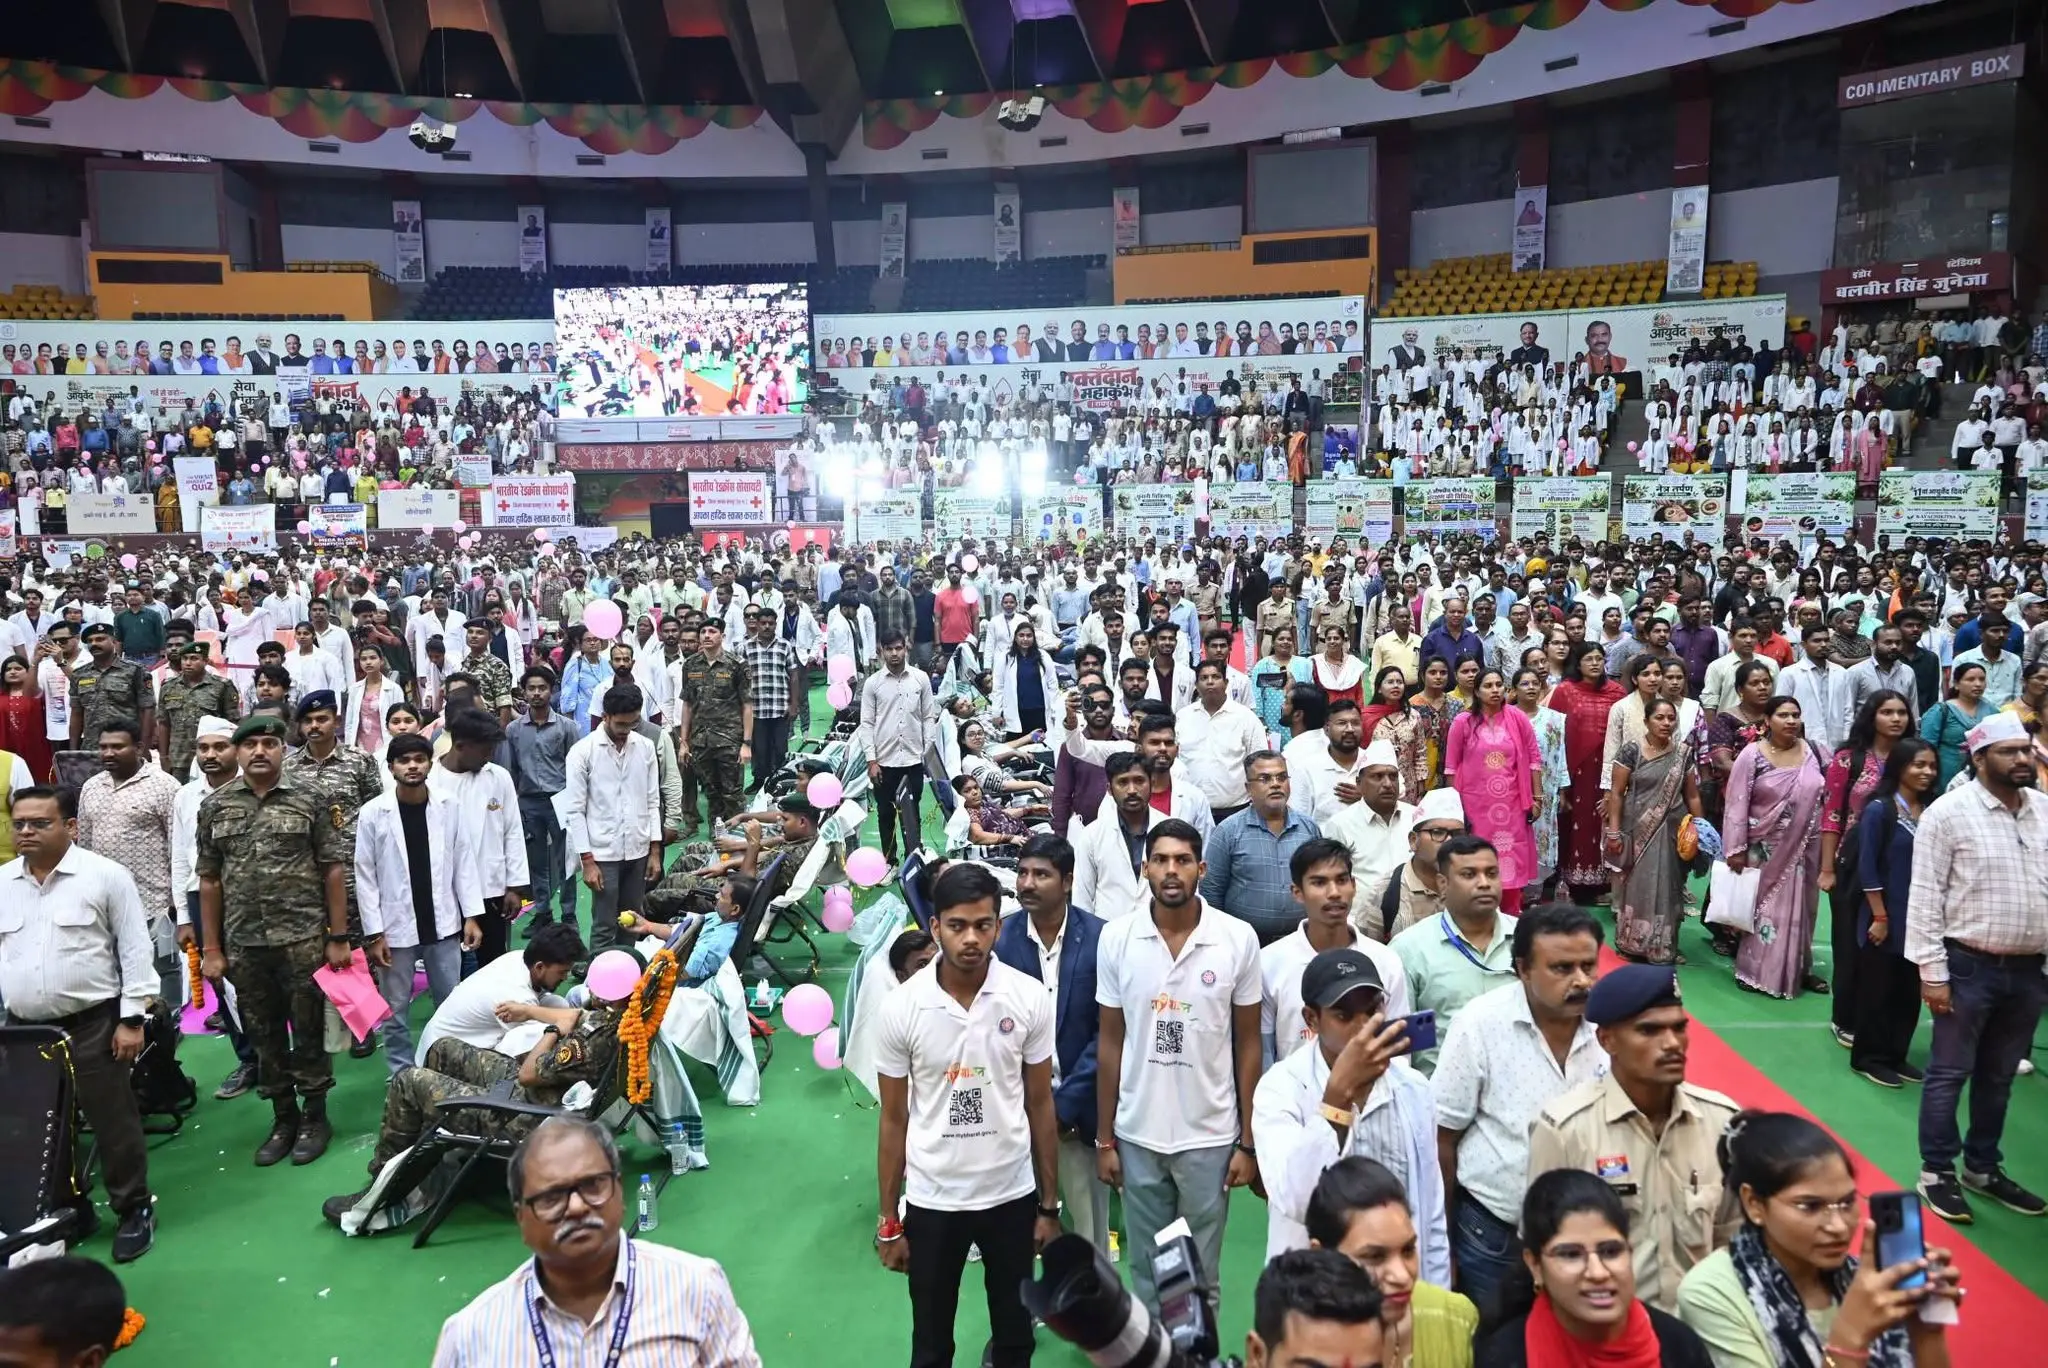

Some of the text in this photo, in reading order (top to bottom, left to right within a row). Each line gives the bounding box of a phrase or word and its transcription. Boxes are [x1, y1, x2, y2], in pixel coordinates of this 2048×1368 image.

[1846, 55, 2011, 99] COMMENTARY BOX
[1852, 257, 1982, 280] इंडोर स्टेडियम
[1836, 271, 1990, 298] बलबीर सिंह जुनेजा
[1649, 322, 1687, 341] आयुर्वेद
[1688, 323, 1706, 337] सेवा
[233, 378, 257, 392] सेवा
[191, 481, 214, 491] QUIZ
[496, 481, 569, 496] भारतीय रेडक्रॉस सोसायटी
[692, 478, 762, 492] भारतीय रेडक्रॉस सोसायटी
[1656, 483, 1694, 492] नेत्र तर्पण
[1929, 486, 1949, 496] आयुर्वेद
[1950, 486, 1968, 495] दिवस
[497, 514, 515, 524] आपका
[516, 512, 533, 525] हार्दिक
[534, 514, 550, 524] स्वागत
[551, 514, 566, 524] करता
[693, 511, 710, 520] आपका
[710, 509, 727, 520] हार्दिक
[728, 511, 743, 520] स्वागत
[744, 511, 759, 520] करता
[941, 1130, 998, 1139] www.mybharat.gov.in
